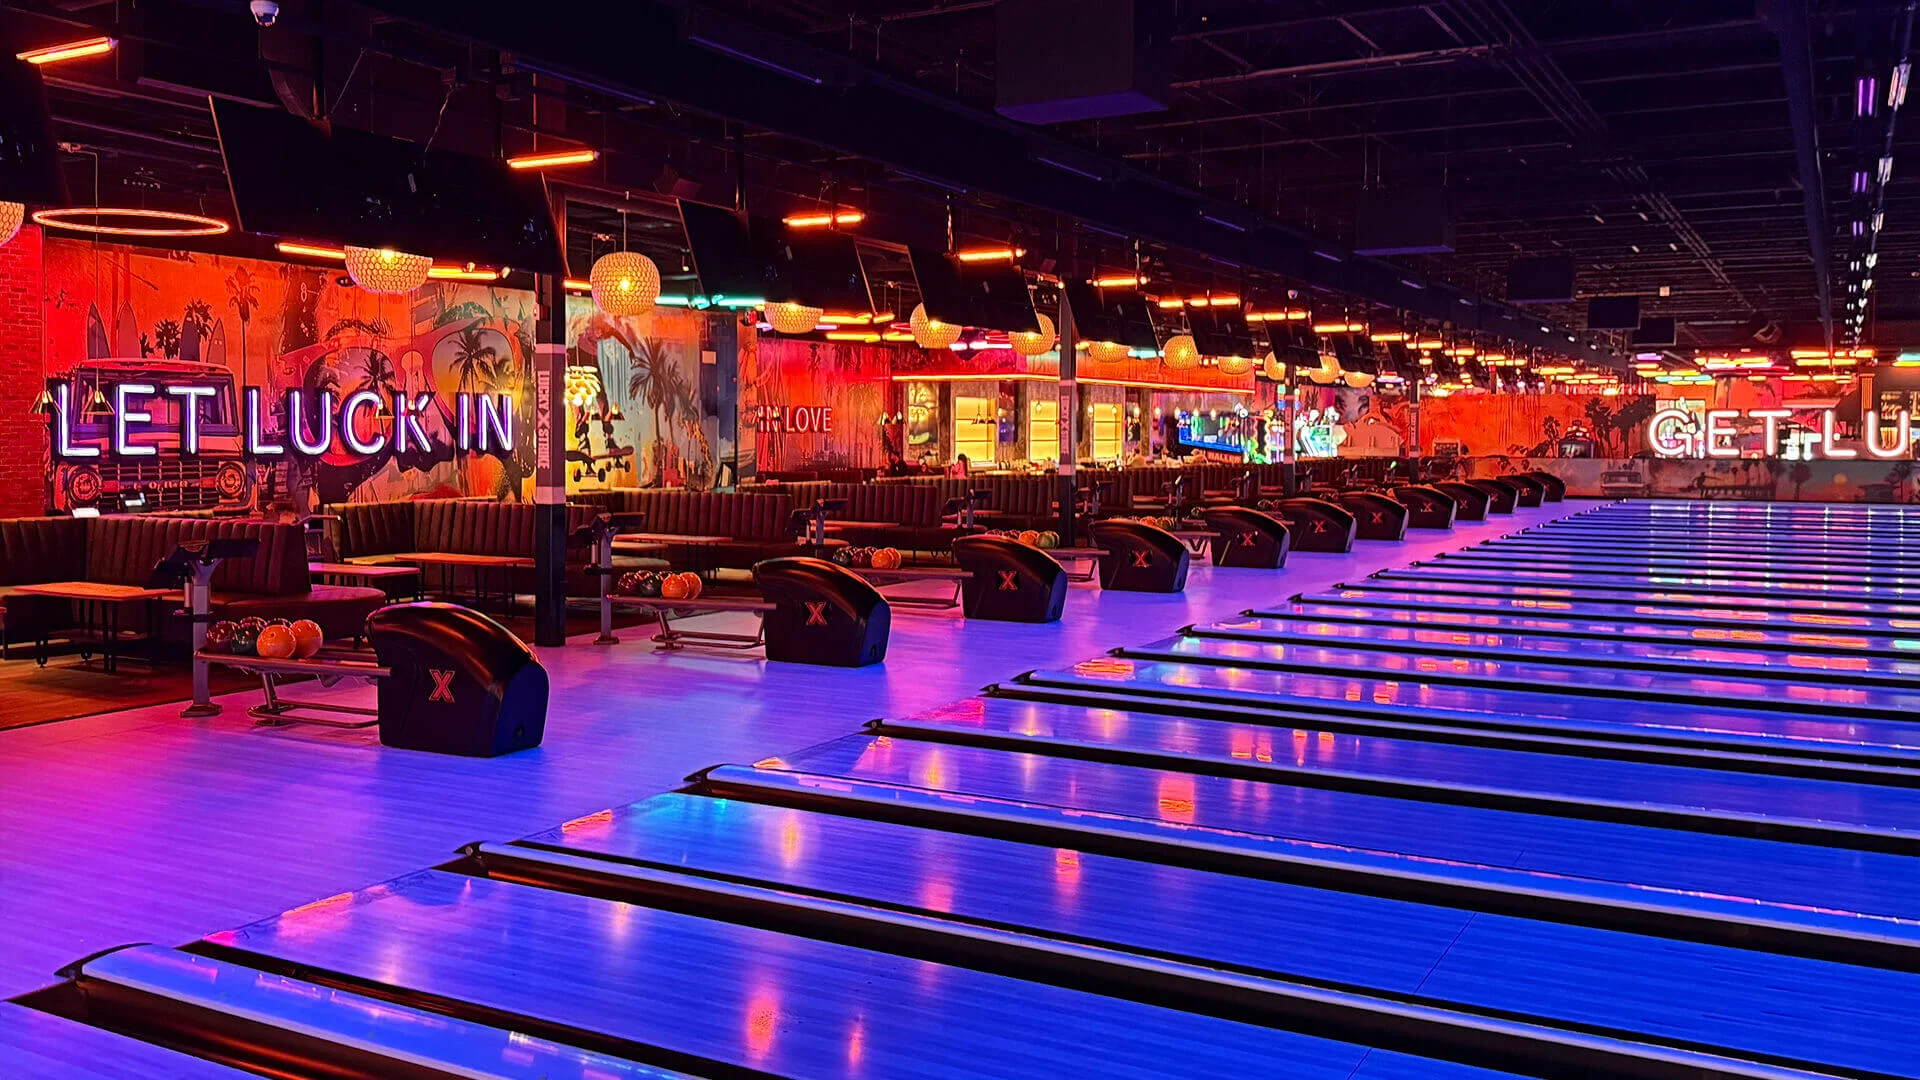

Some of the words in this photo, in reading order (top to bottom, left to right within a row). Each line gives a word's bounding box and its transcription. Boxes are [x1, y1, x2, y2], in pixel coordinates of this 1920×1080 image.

[538, 370, 550, 409] LUCKY
[57, 383, 217, 457] LET
[247, 387, 433, 455] LUCK
[458, 391, 514, 451] IN
[786, 407, 832, 432] LOVE
[1649, 409, 1793, 457] GET
[538, 429, 550, 469] STRIKE
[805, 601, 828, 626] X
[429, 668, 456, 702] X
